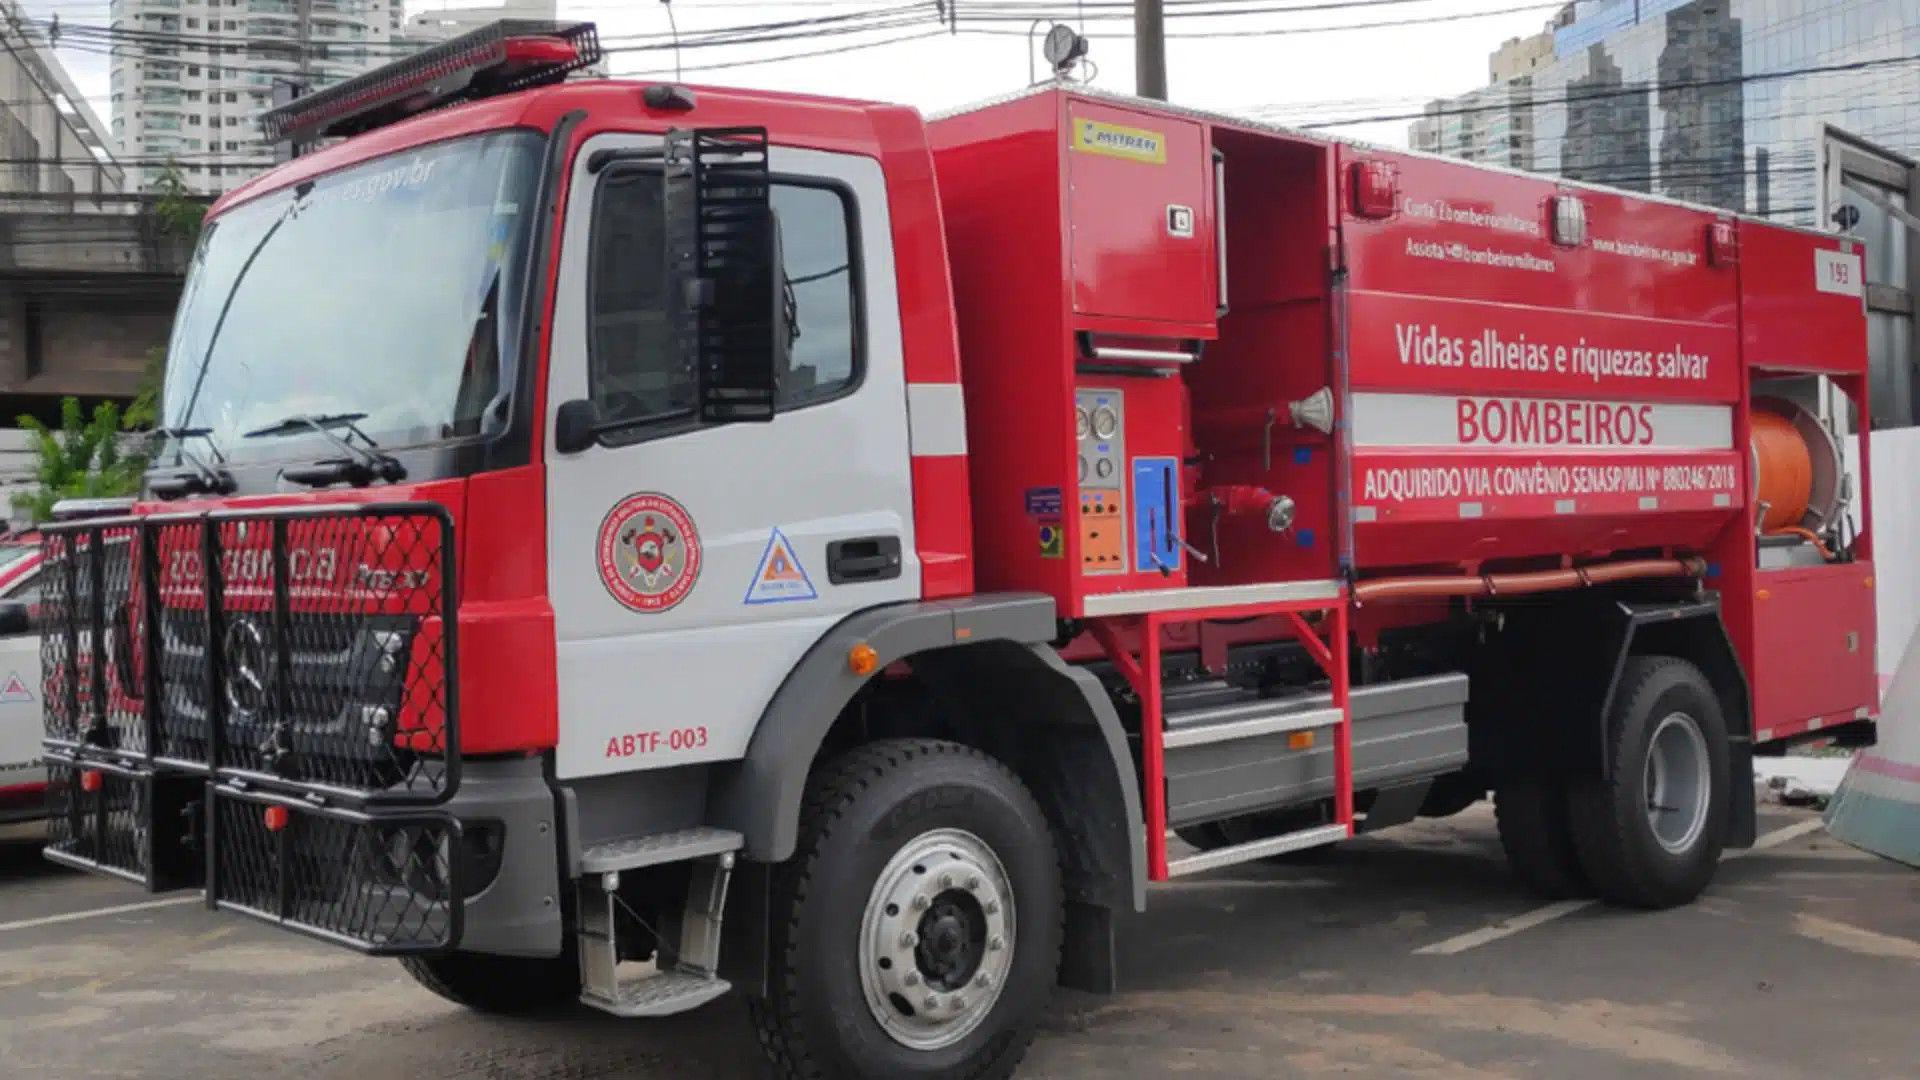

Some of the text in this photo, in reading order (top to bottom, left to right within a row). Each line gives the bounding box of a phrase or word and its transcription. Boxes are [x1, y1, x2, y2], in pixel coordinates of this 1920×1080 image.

[1829, 262, 1849, 285] 193
[1395, 323, 1710, 383] Vidas alheias e riquezas salvar
[1457, 399, 1653, 446] BOMBEIROS
[1364, 467, 1461, 502] ADQUIRIDO
[1463, 467, 1491, 496] VIA
[1494, 461, 1570, 494] CONVÊNIO
[606, 726, 708, 758] ABTF-003
